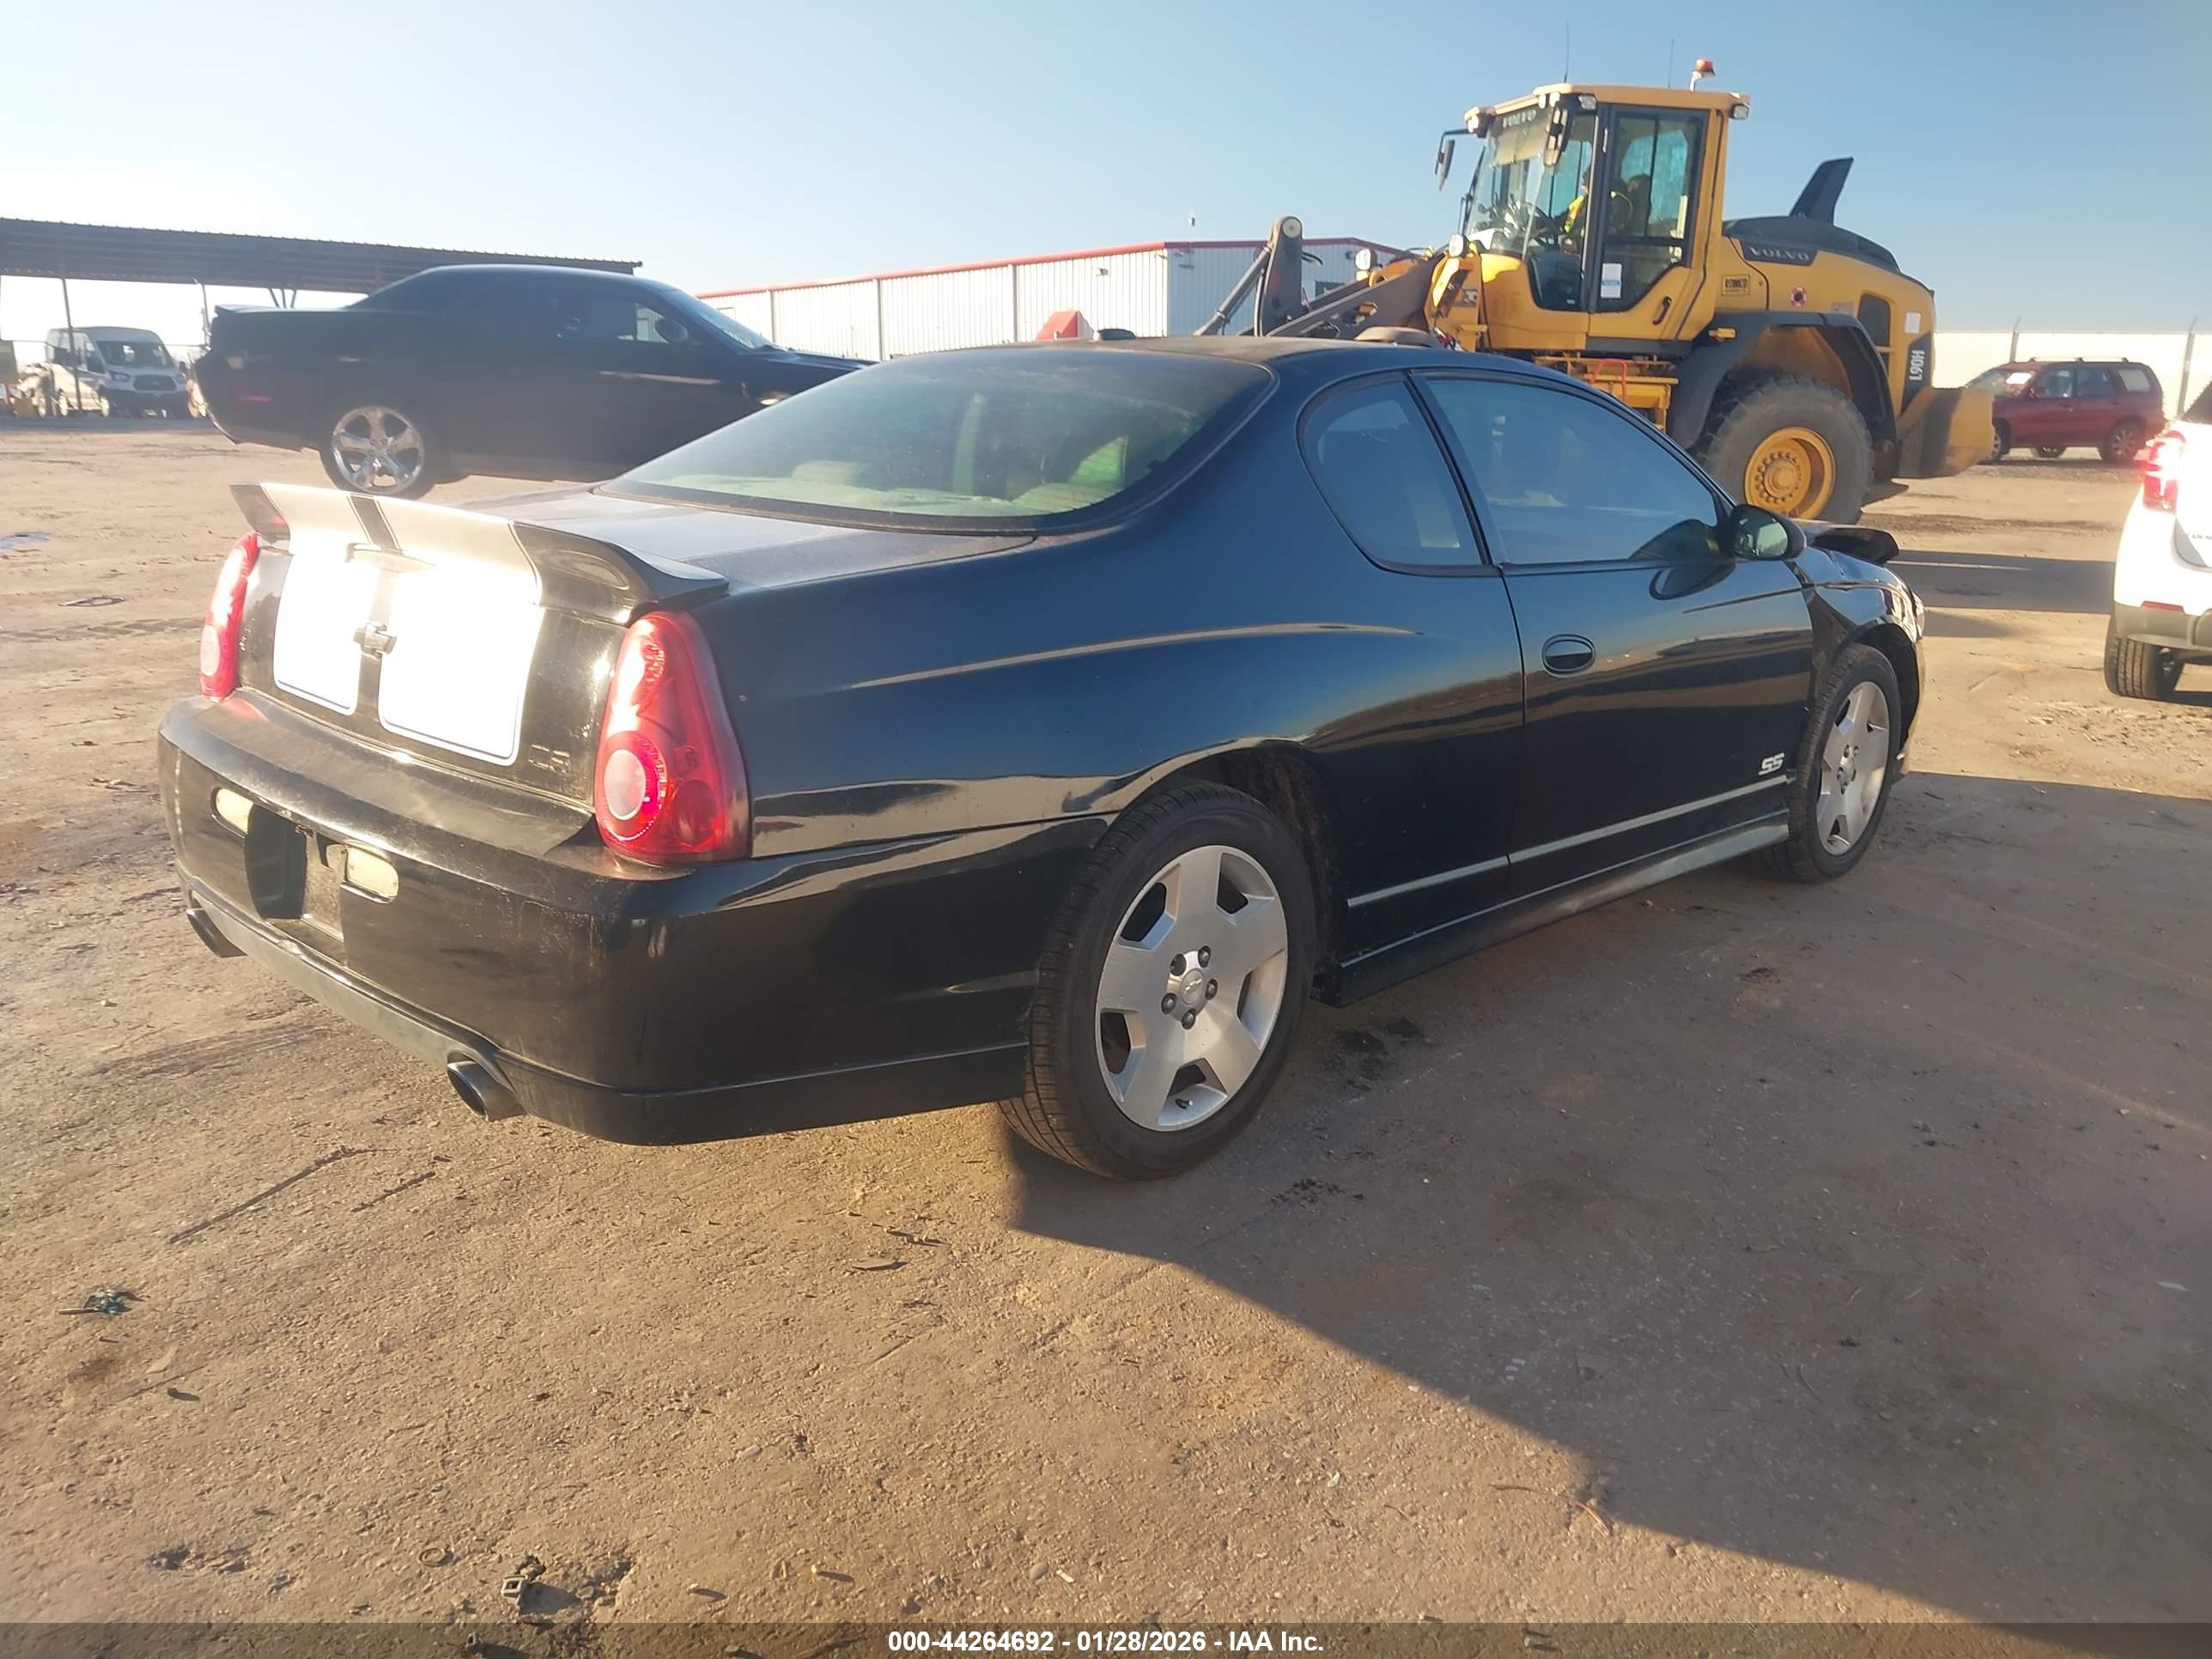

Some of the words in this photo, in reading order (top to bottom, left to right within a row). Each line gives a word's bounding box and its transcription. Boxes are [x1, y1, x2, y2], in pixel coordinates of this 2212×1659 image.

[1503, 109, 1537, 128] VOLVO
[1747, 246, 1810, 260] VOLVO
[1908, 349, 1926, 381] L90H
[1758, 752, 1785, 775] SS
